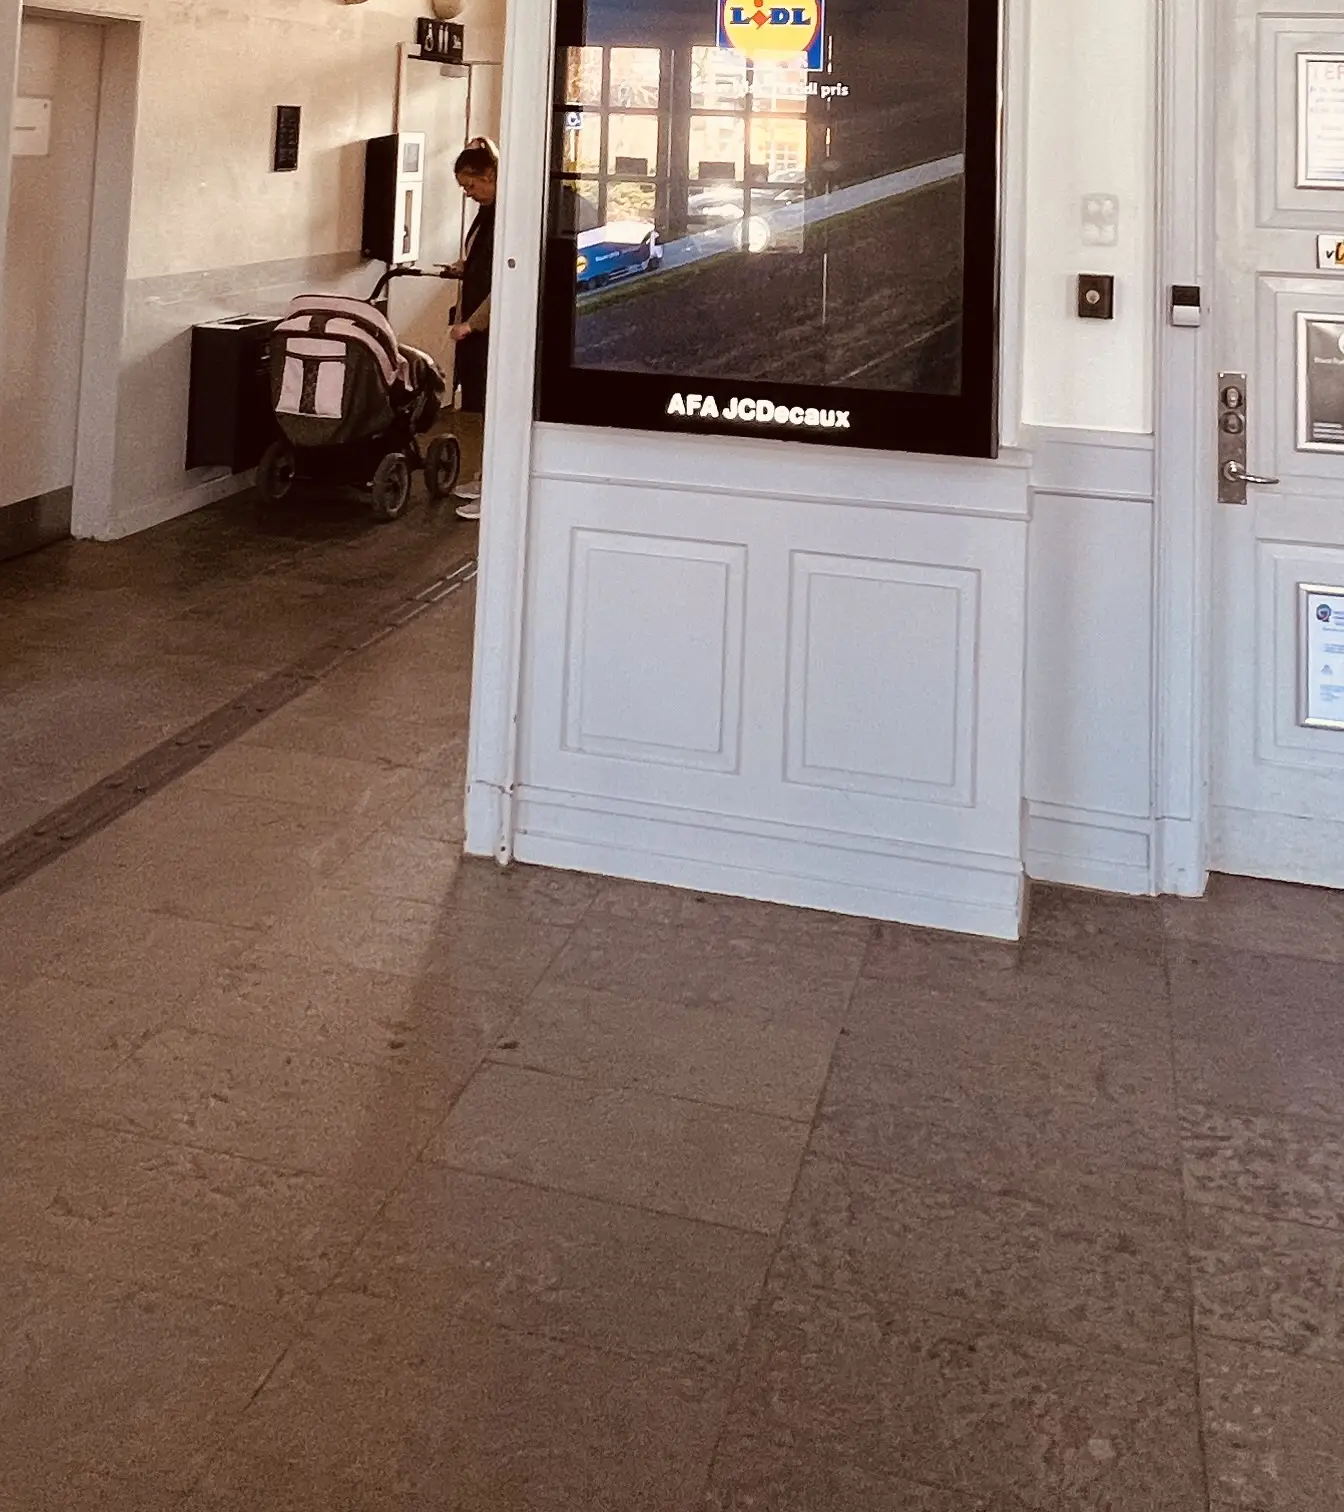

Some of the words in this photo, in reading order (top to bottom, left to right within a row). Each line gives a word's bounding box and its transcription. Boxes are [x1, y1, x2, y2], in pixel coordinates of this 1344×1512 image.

[820, 82, 850, 99] pris
[667, 392, 720, 419] AFA
[722, 396, 851, 429] JCDecaux
